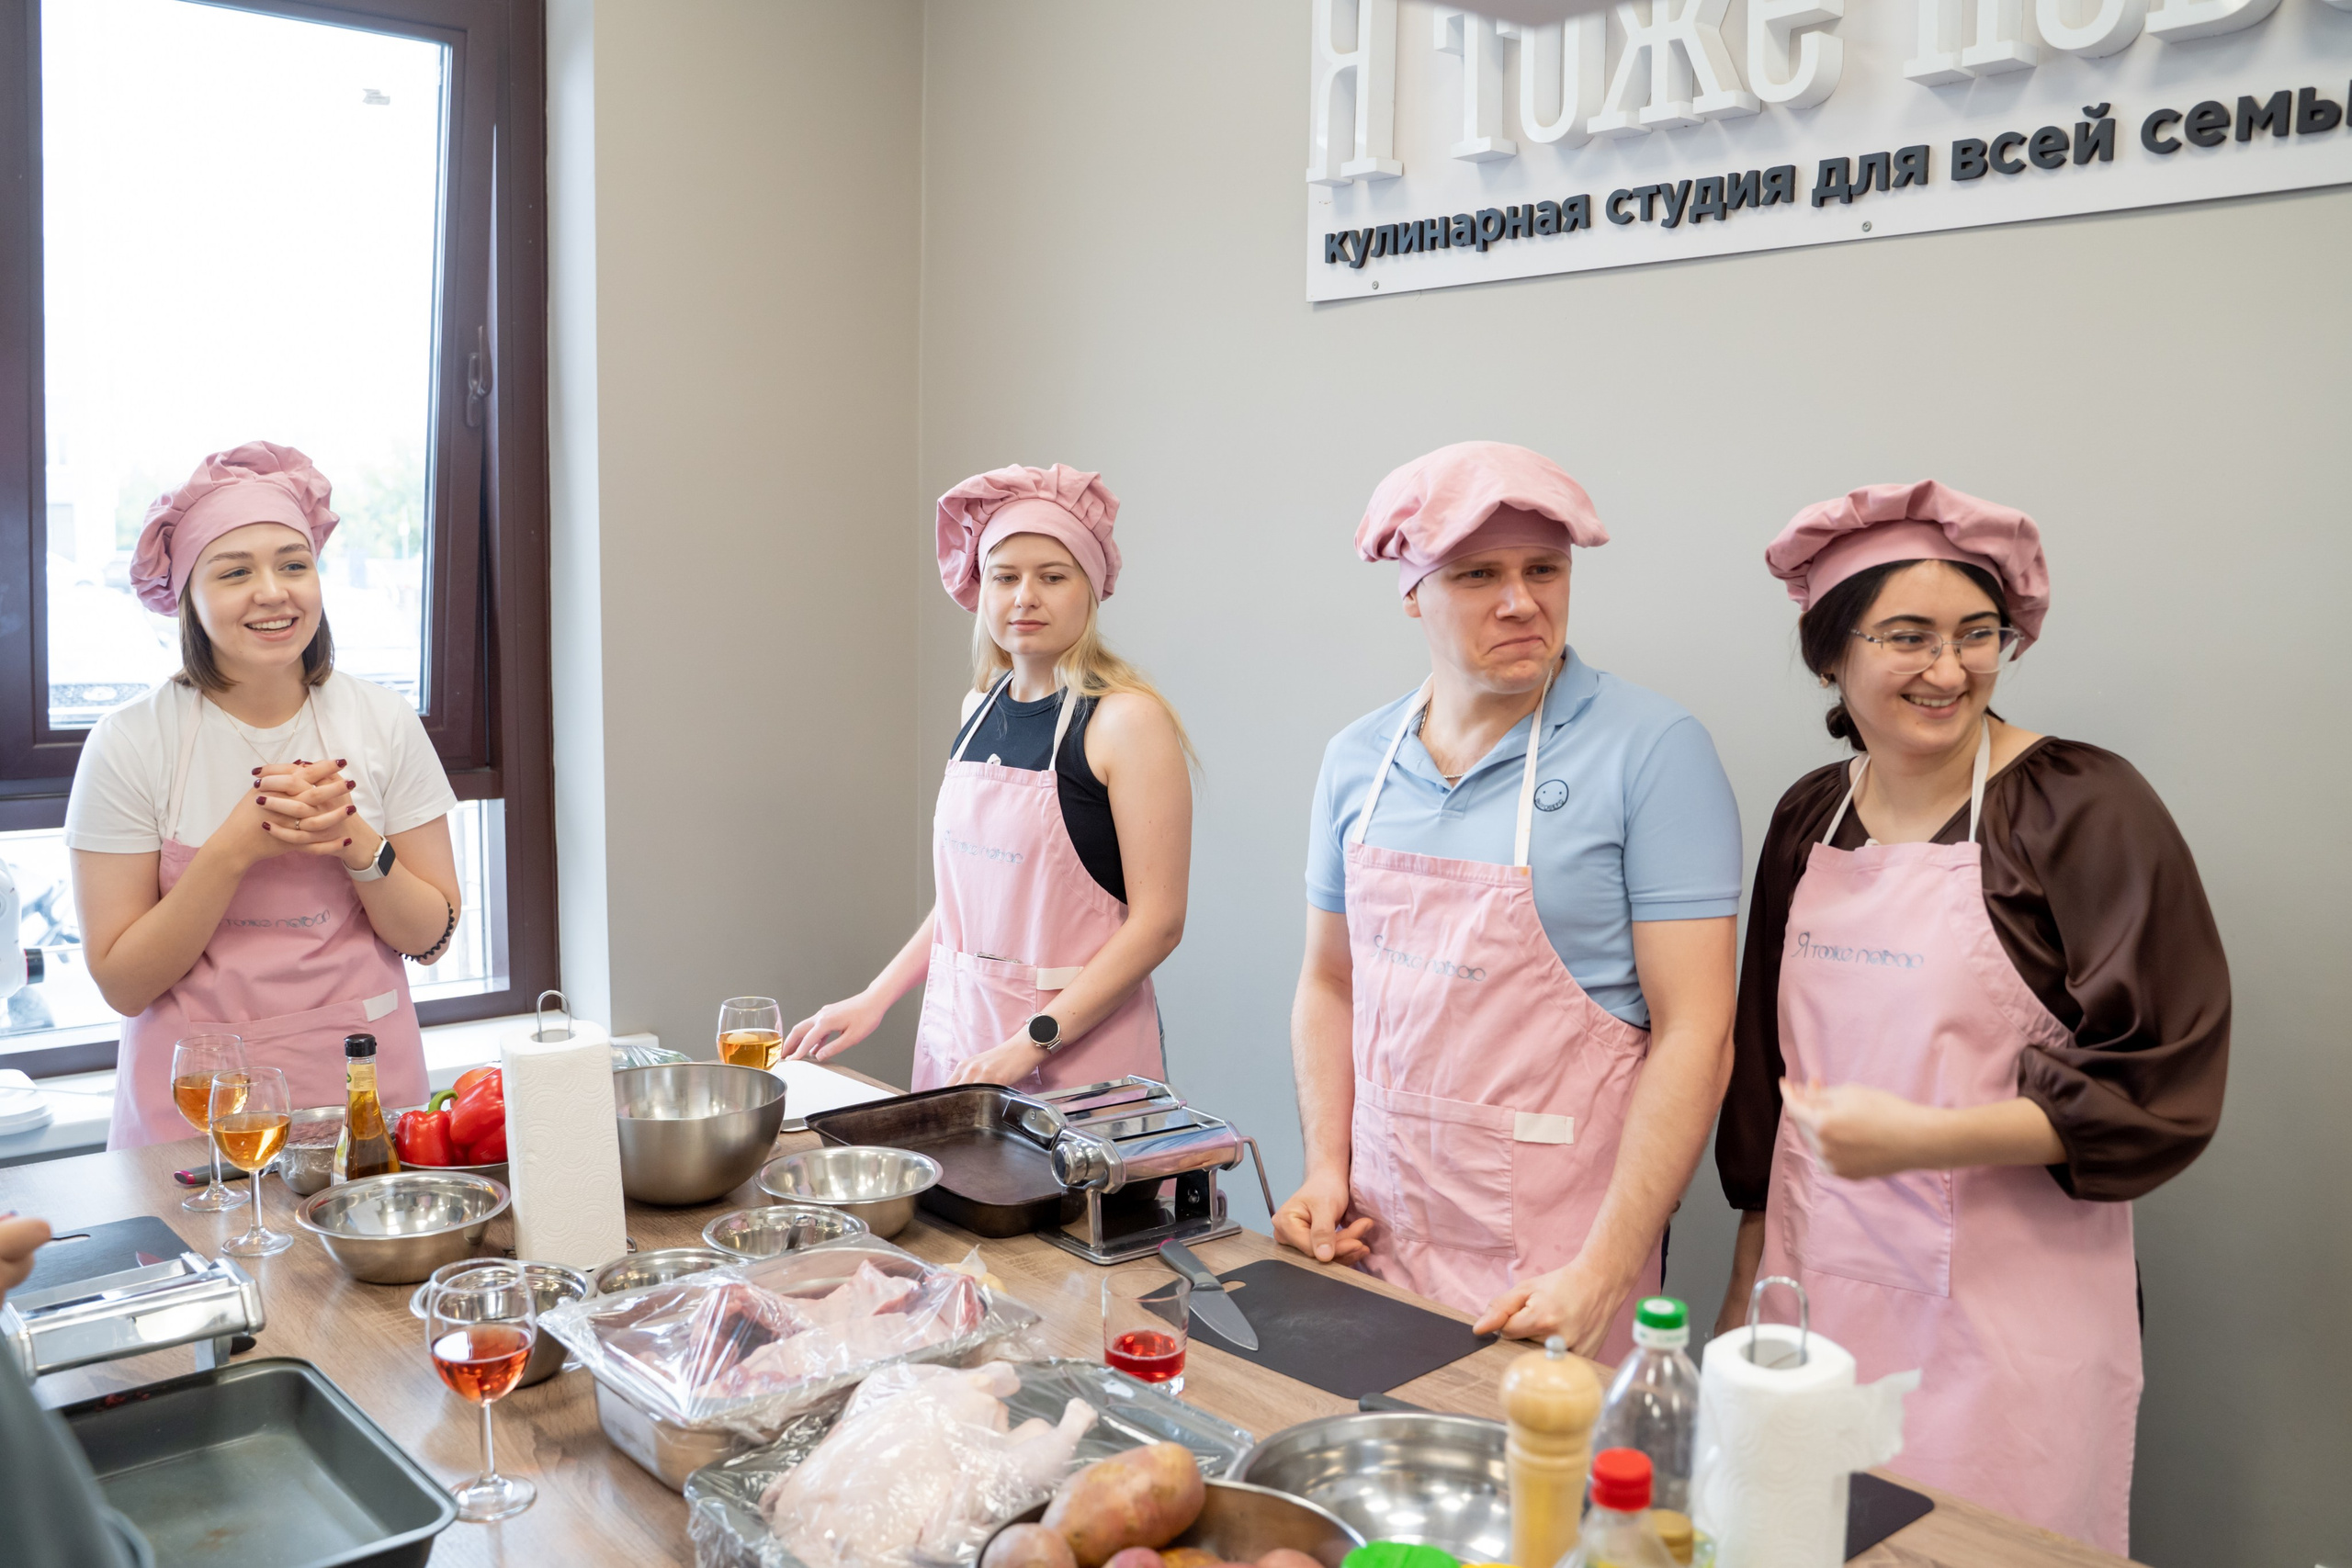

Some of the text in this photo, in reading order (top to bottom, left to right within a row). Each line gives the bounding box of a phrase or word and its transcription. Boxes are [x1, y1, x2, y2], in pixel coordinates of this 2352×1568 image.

[1306, 0, 1403, 186] Я
[1325, 79, 2352, 268] кулинарная студия для всей семь
[1791, 931, 1924, 969] Я тоже повар
